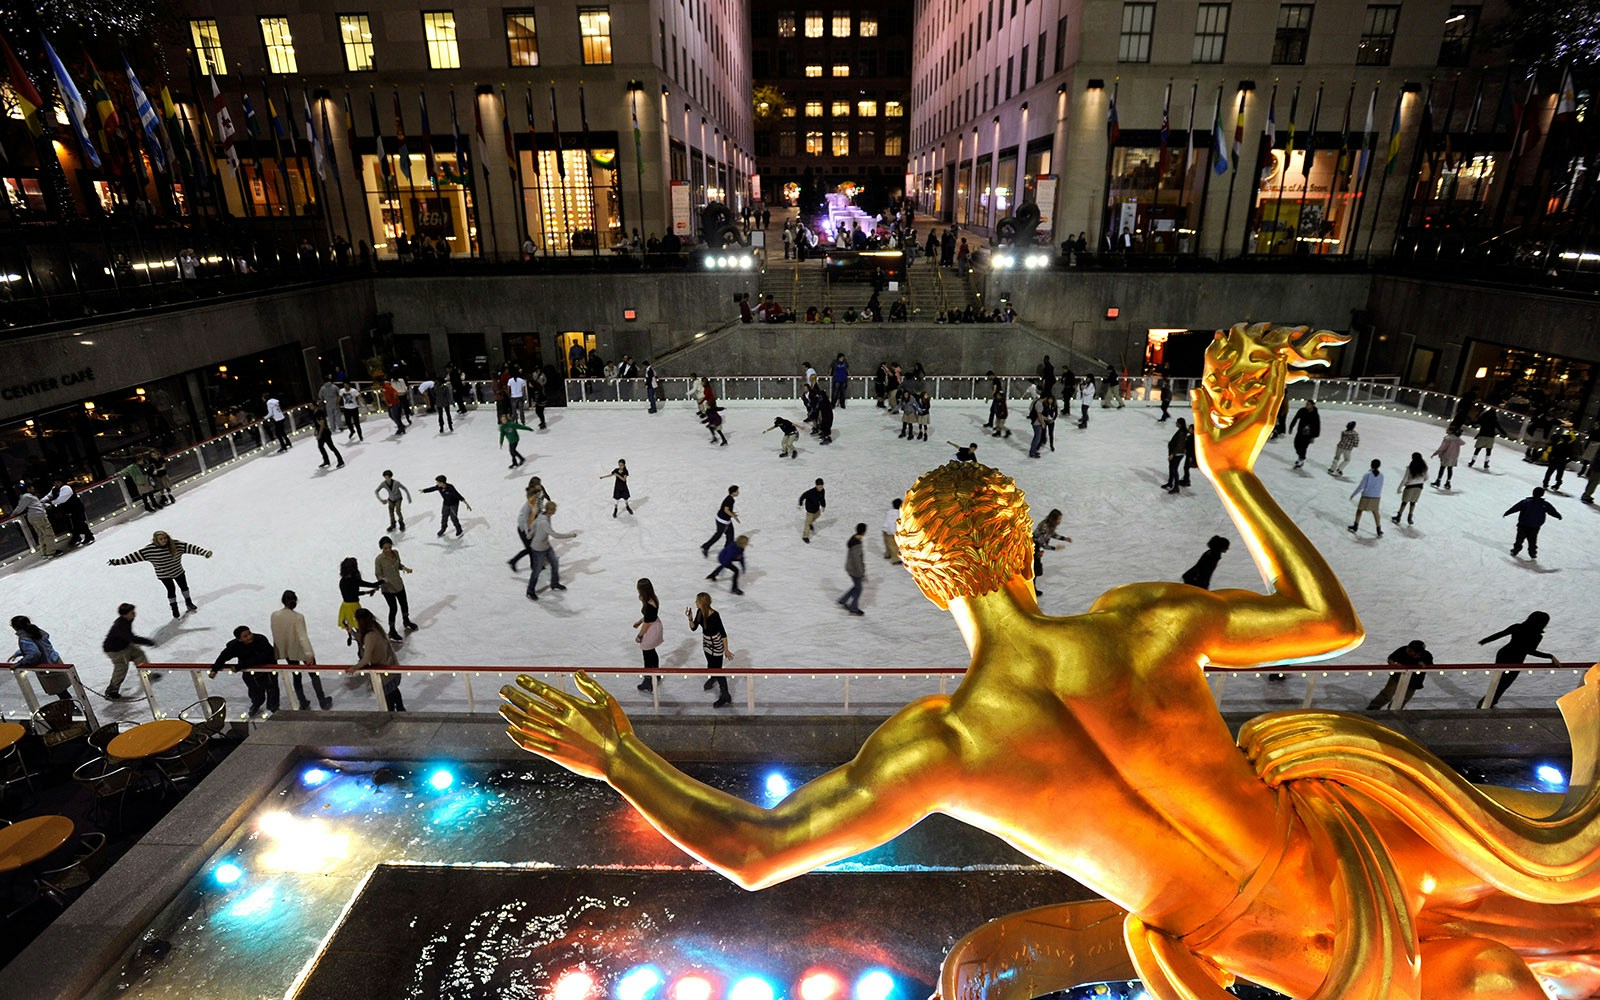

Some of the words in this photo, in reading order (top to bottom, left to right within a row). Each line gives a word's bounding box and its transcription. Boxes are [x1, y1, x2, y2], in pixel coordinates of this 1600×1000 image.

[1310, 183, 1328, 192] Store
[418, 211, 448, 227] LEGO
[2, 377, 59, 401] CENTER
[61, 366, 96, 386] CAFÉ
